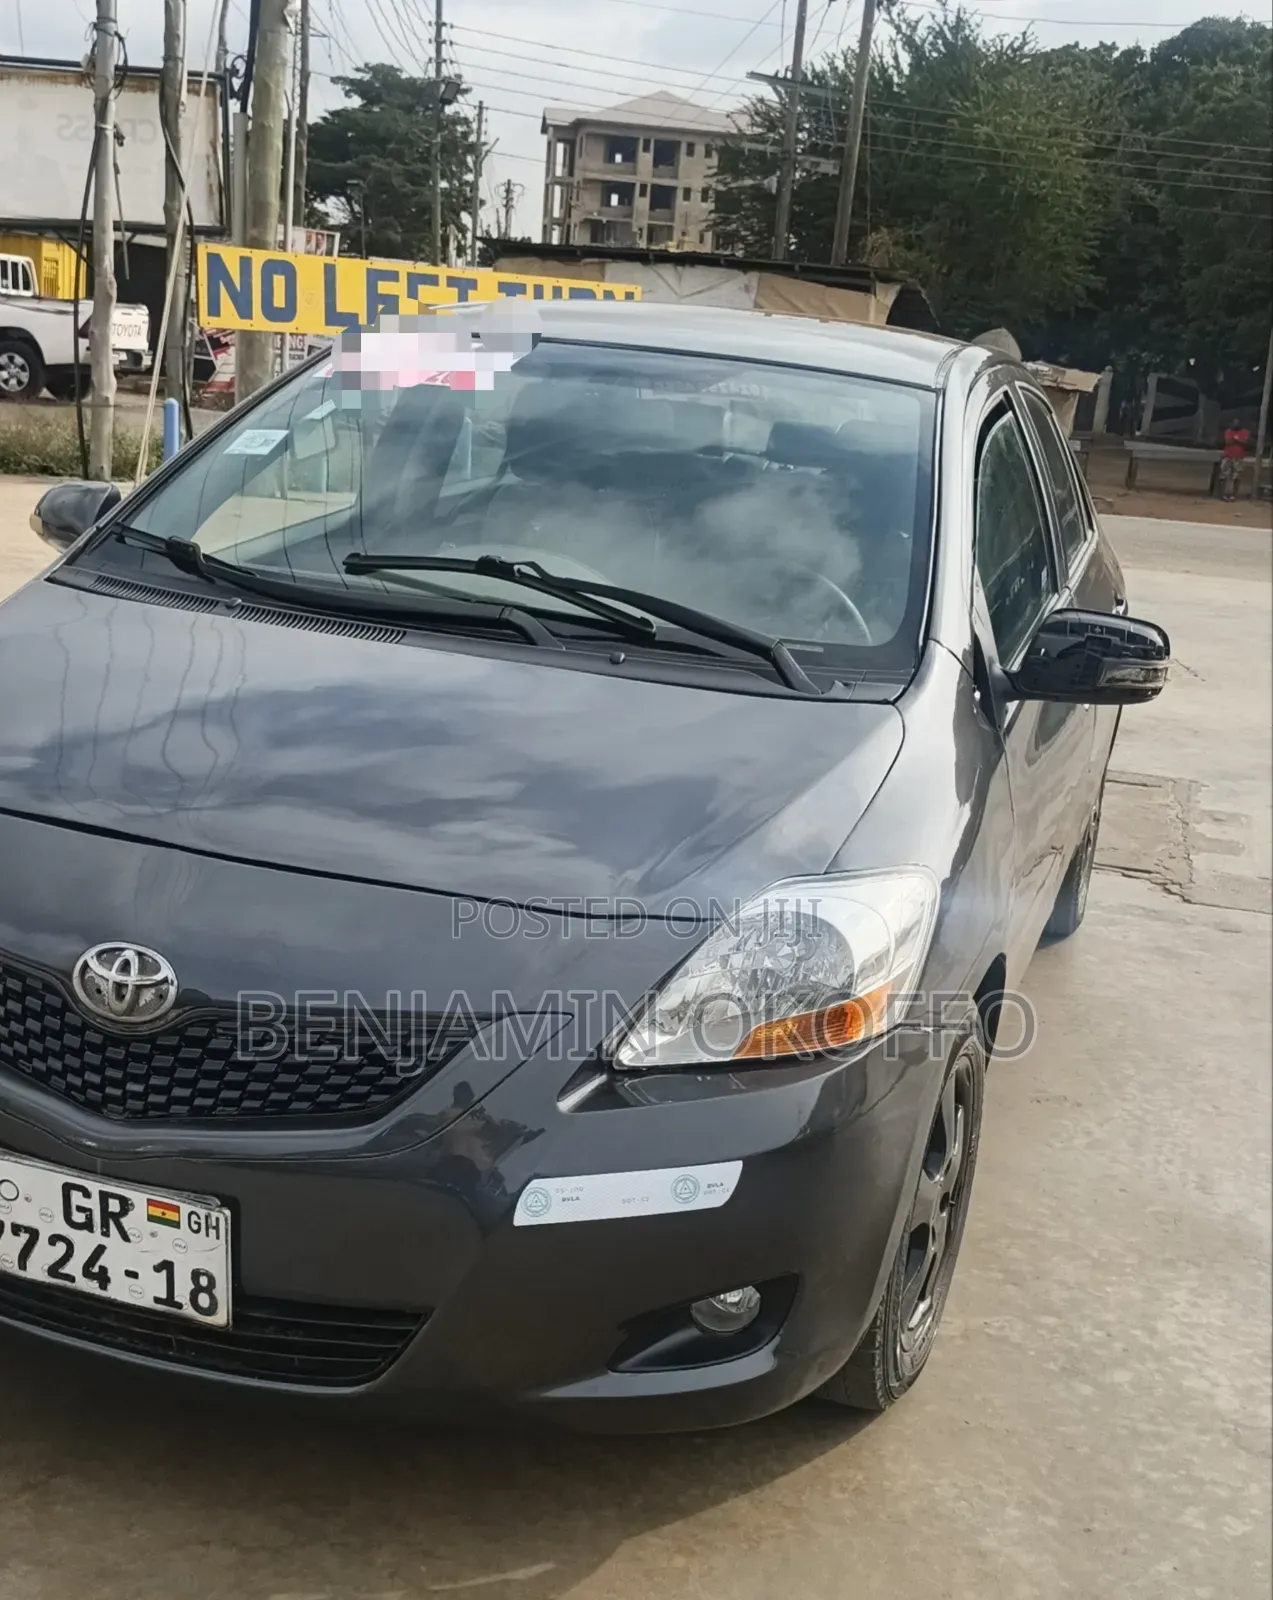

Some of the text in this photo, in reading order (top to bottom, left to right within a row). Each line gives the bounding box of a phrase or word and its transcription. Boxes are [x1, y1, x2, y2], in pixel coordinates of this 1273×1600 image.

[207, 253, 297, 323] NO
[112, 323, 142, 338] TOYOTA
[62, 1182, 220, 1242] GR GH
[0, 1219, 218, 1317] 724-18
